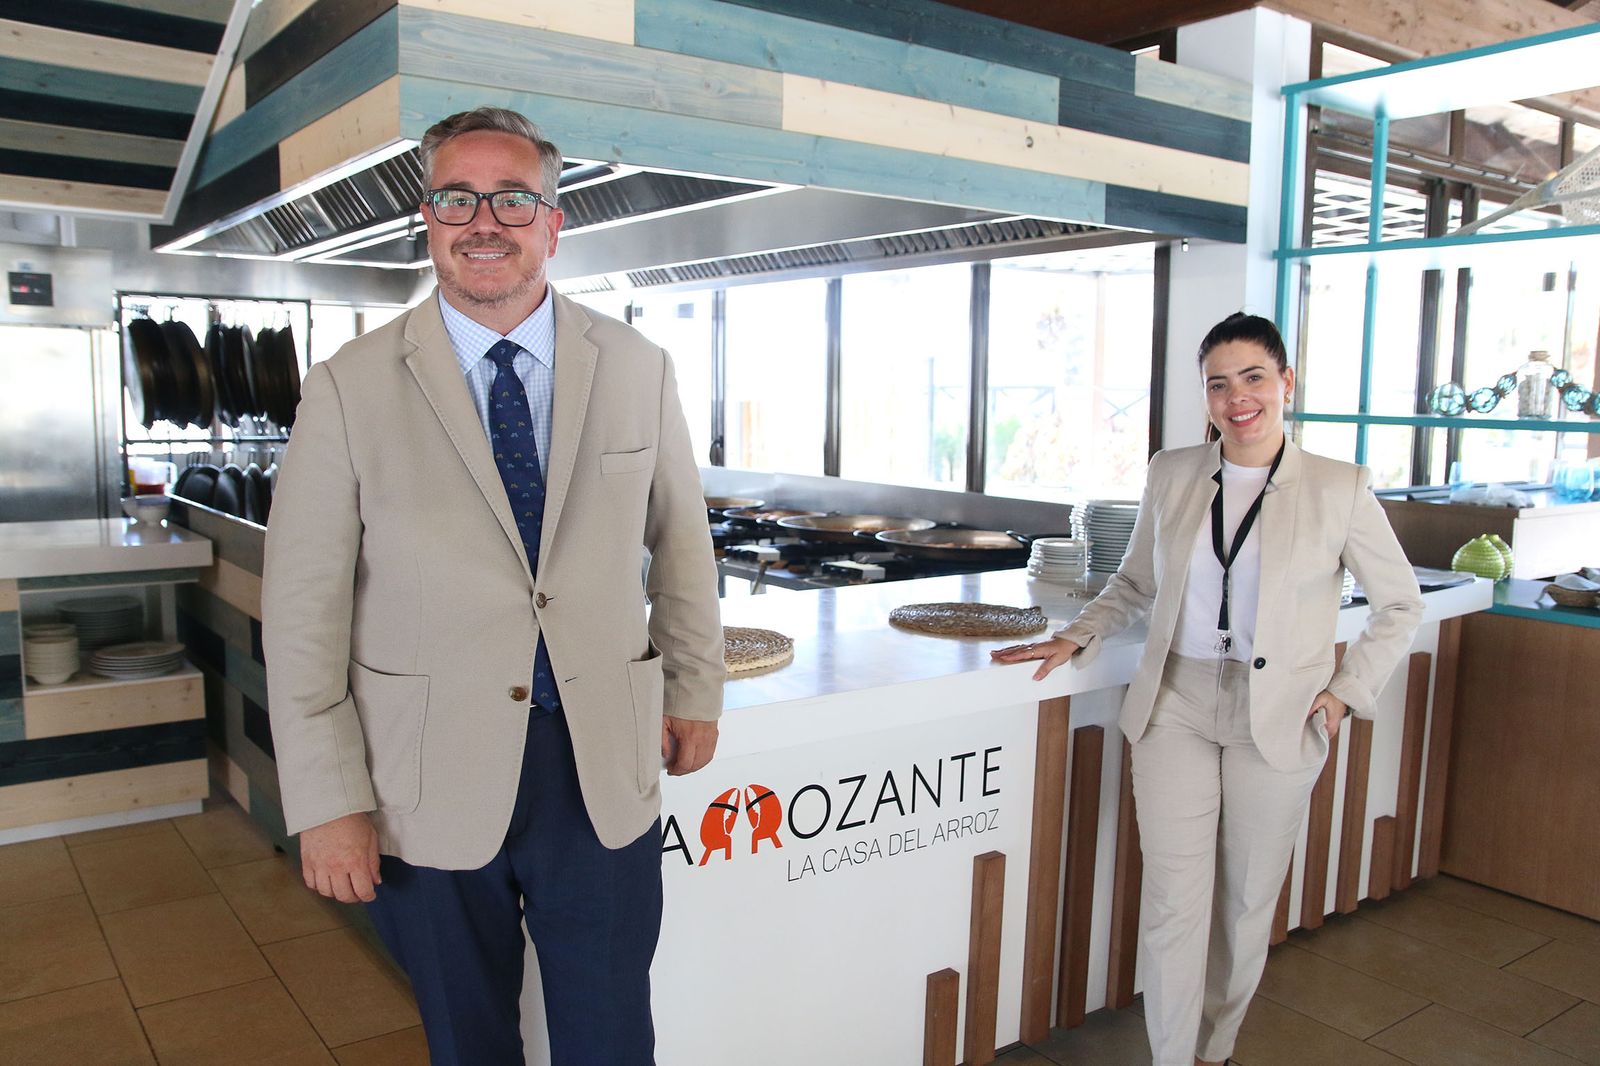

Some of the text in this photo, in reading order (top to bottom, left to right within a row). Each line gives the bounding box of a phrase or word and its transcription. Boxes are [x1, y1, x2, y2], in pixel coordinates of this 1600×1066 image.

[787, 808, 999, 882] LA CASA DEL ARROZ
